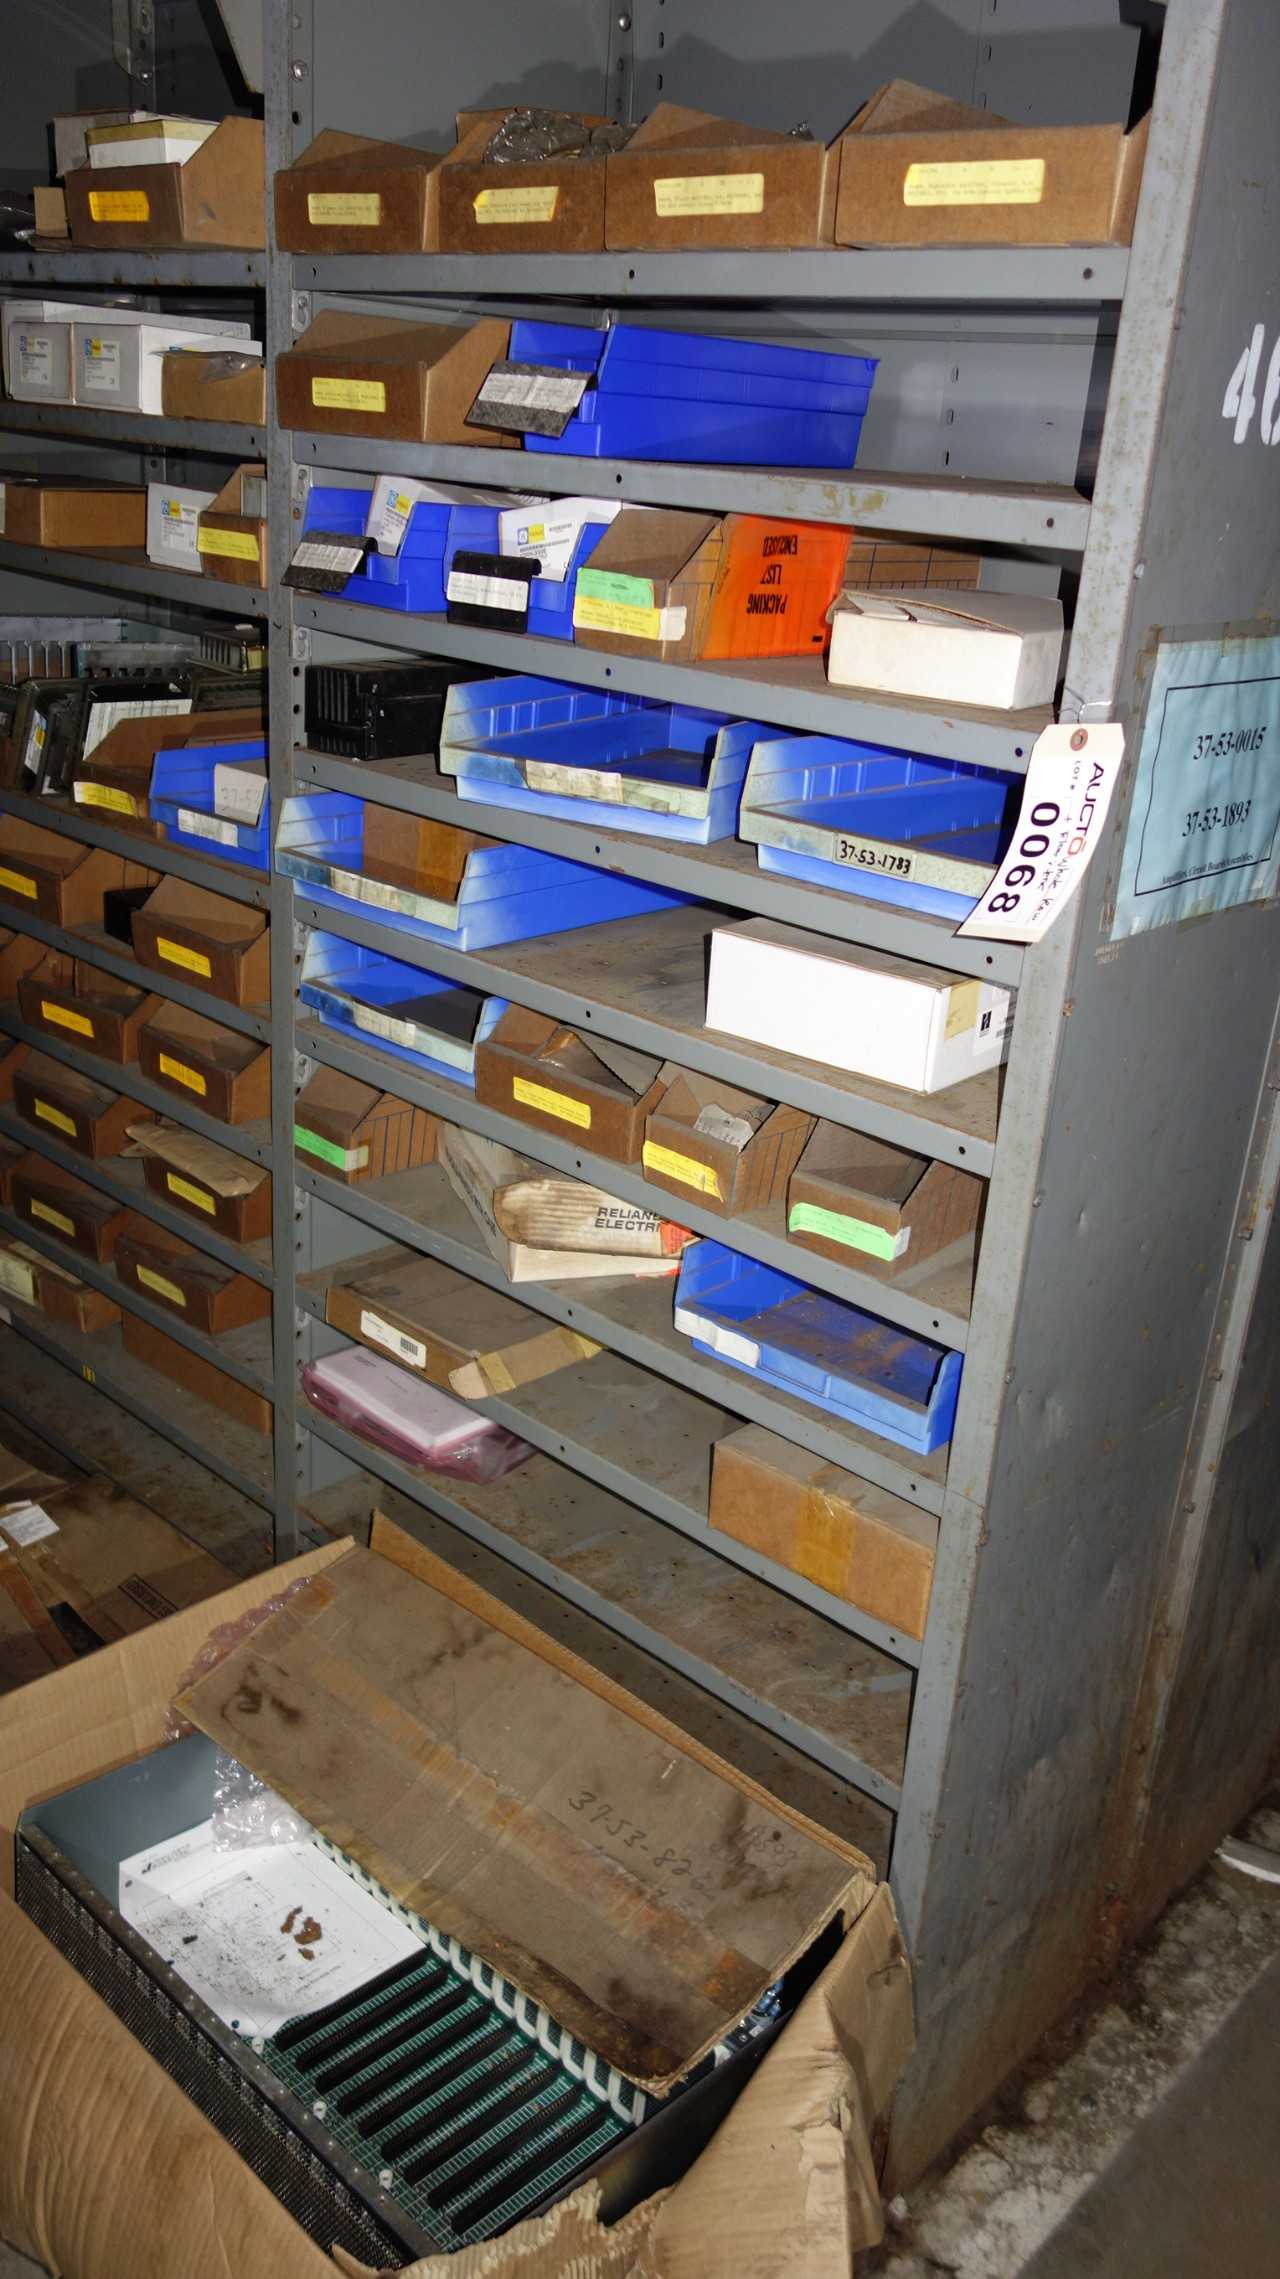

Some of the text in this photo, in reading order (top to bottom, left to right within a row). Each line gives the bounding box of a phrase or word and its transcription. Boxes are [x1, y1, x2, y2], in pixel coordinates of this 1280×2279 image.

[762, 535, 798, 557] ENCLOSED
[760, 564, 782, 585] LIST
[746, 594, 787, 614] PACKING
[1193, 726, 1267, 760] 37-53-0015
[1182, 799, 1252, 837] 37-53-1893
[840, 840, 911, 874] 37-53-1783
[987, 802, 1061, 914] 0068
